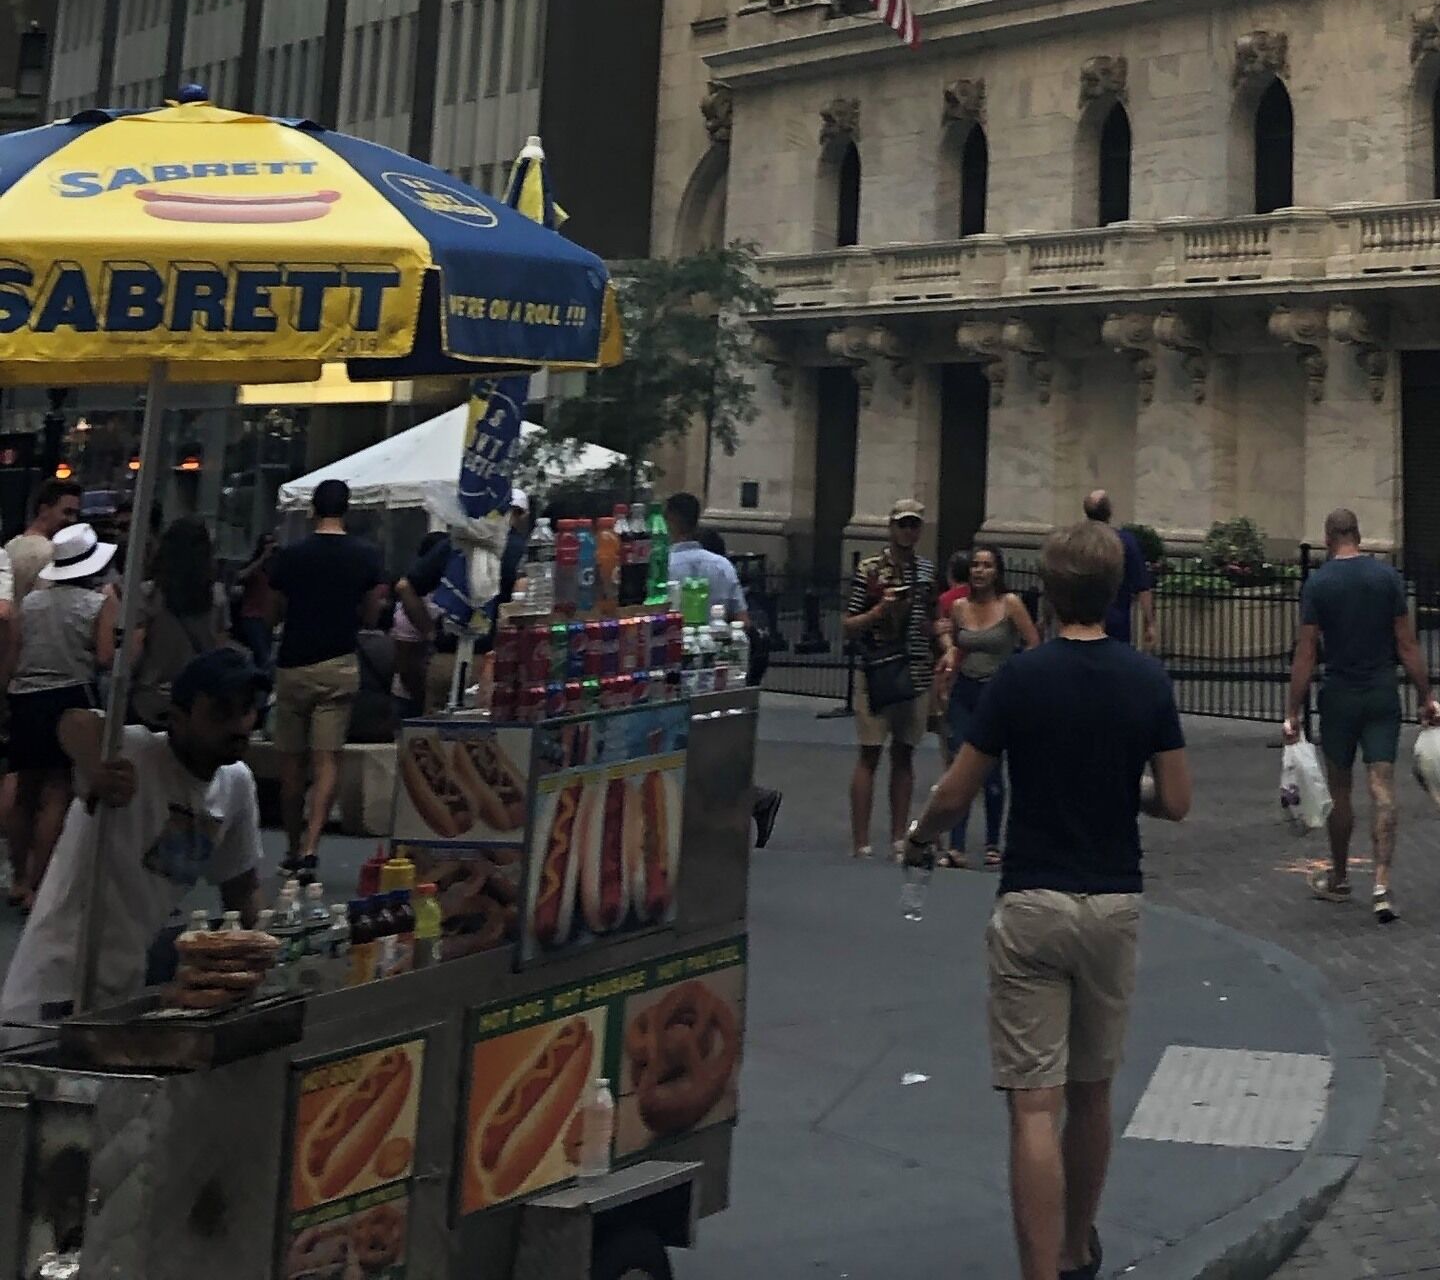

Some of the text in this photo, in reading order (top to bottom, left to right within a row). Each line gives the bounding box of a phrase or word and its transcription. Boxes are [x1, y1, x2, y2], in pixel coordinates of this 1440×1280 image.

[56, 160, 319, 198] SABRETT
[0, 260, 401, 333] SABRETT
[523, 302, 562, 326] ROLL
